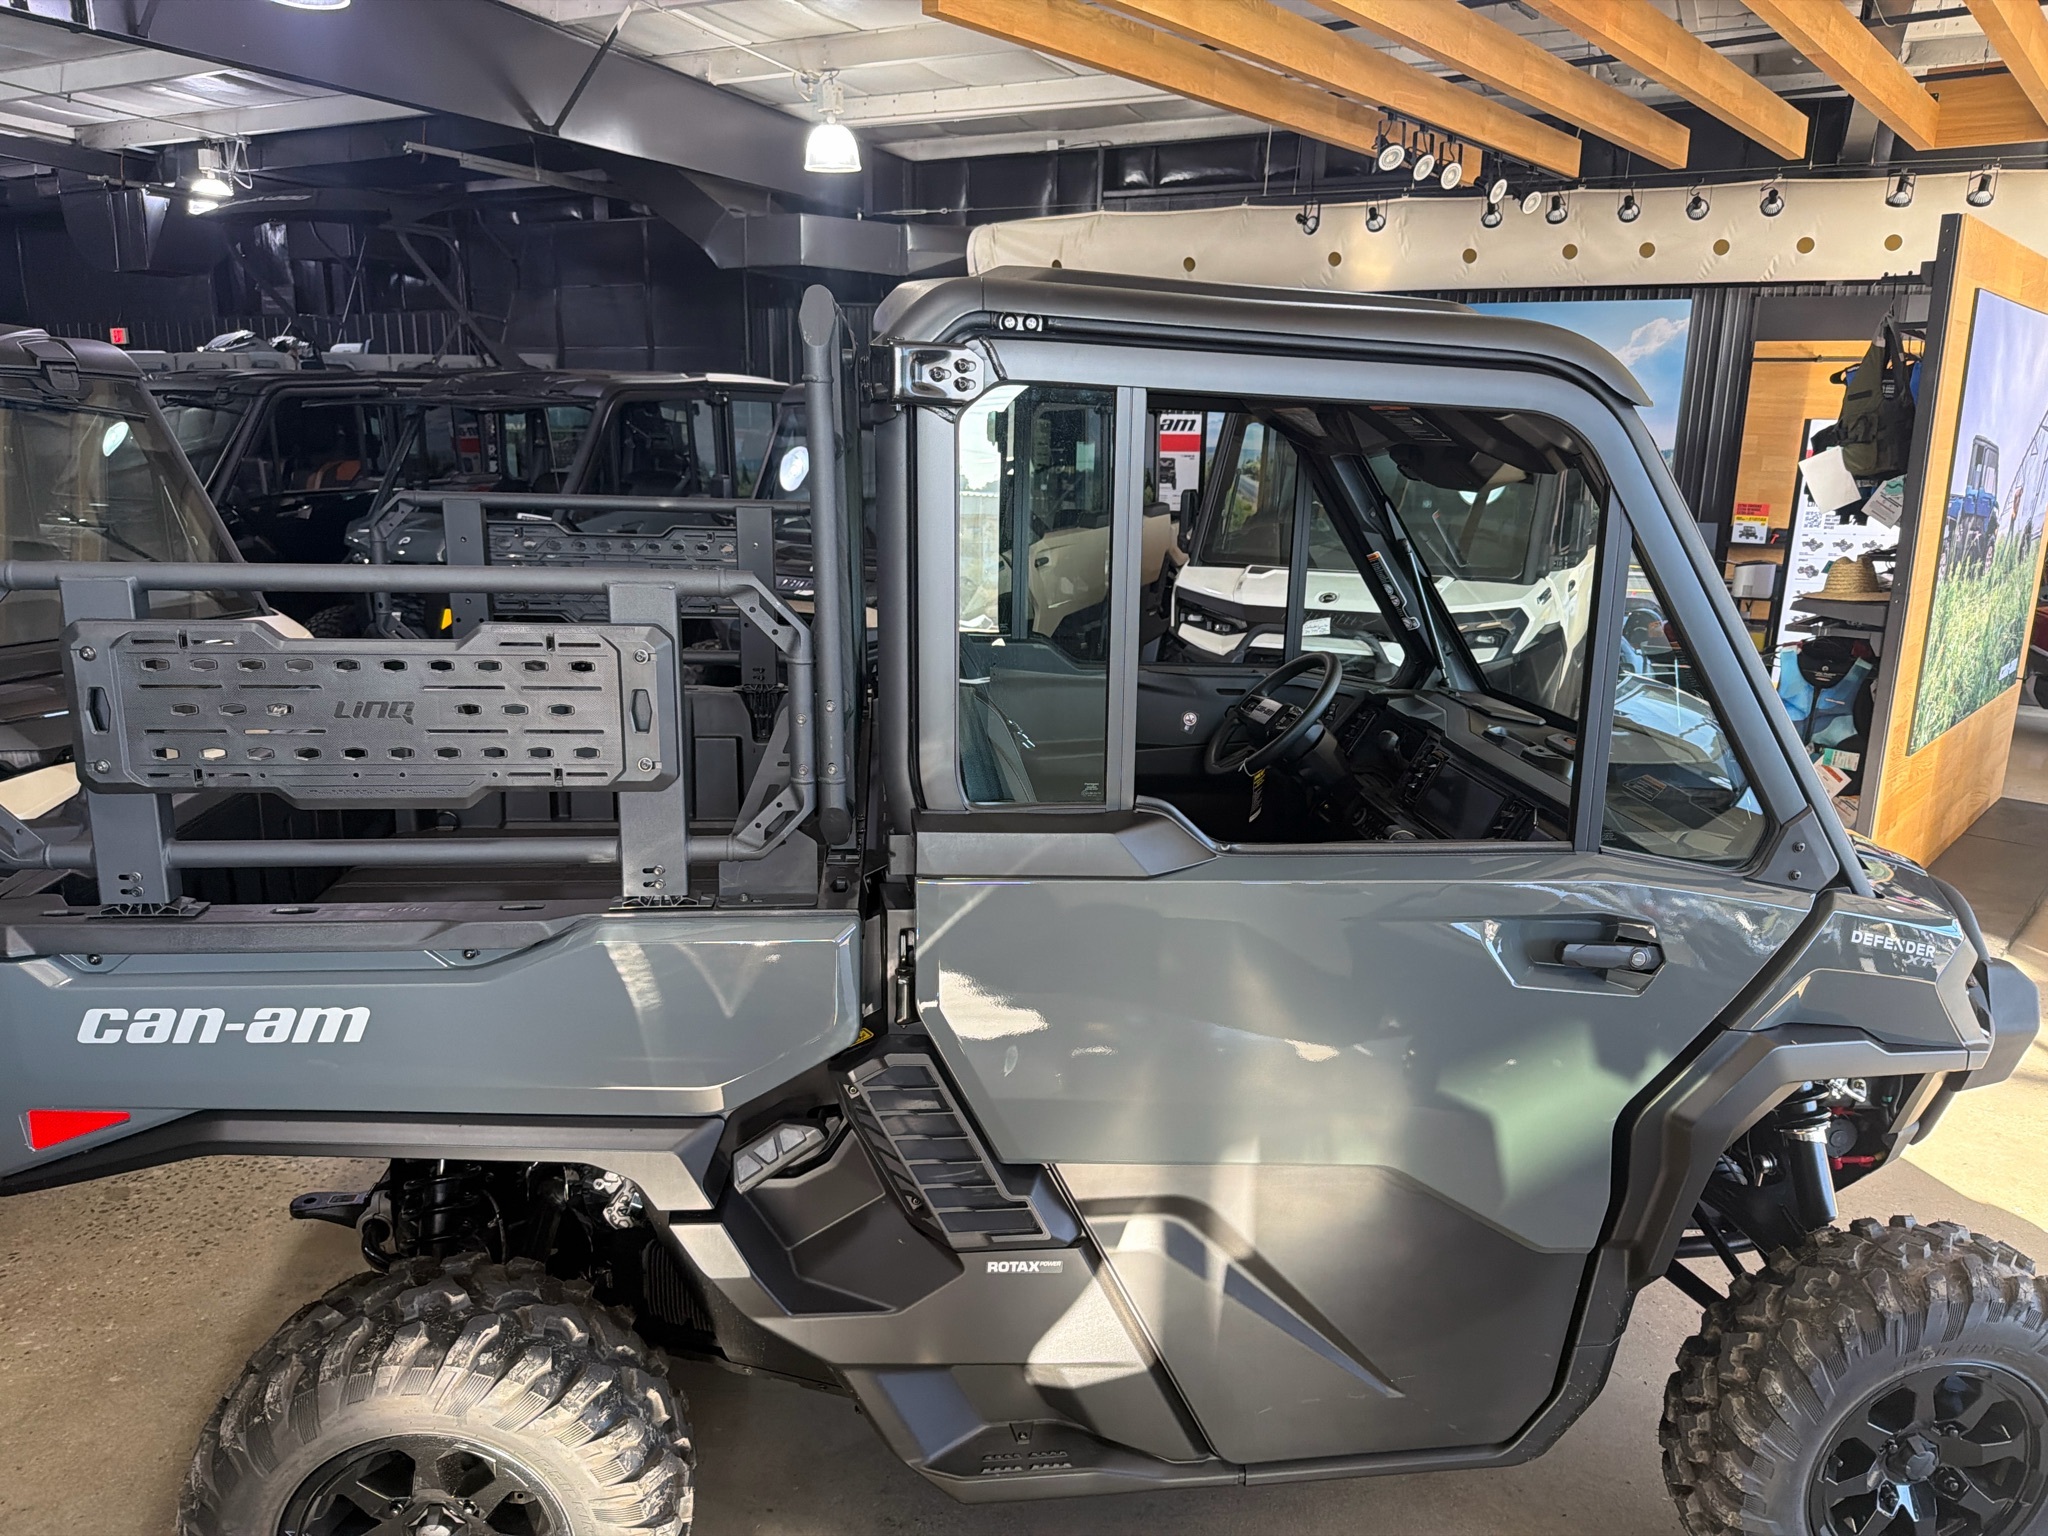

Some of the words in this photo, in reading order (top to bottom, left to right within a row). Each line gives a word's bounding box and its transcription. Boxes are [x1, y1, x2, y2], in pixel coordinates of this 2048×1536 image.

[1850, 930, 1936, 958] DEFENDER
[1904, 955, 1933, 967] XT
[76, 1006, 371, 1045] can-am
[987, 1261, 1040, 1273] ROTAX
